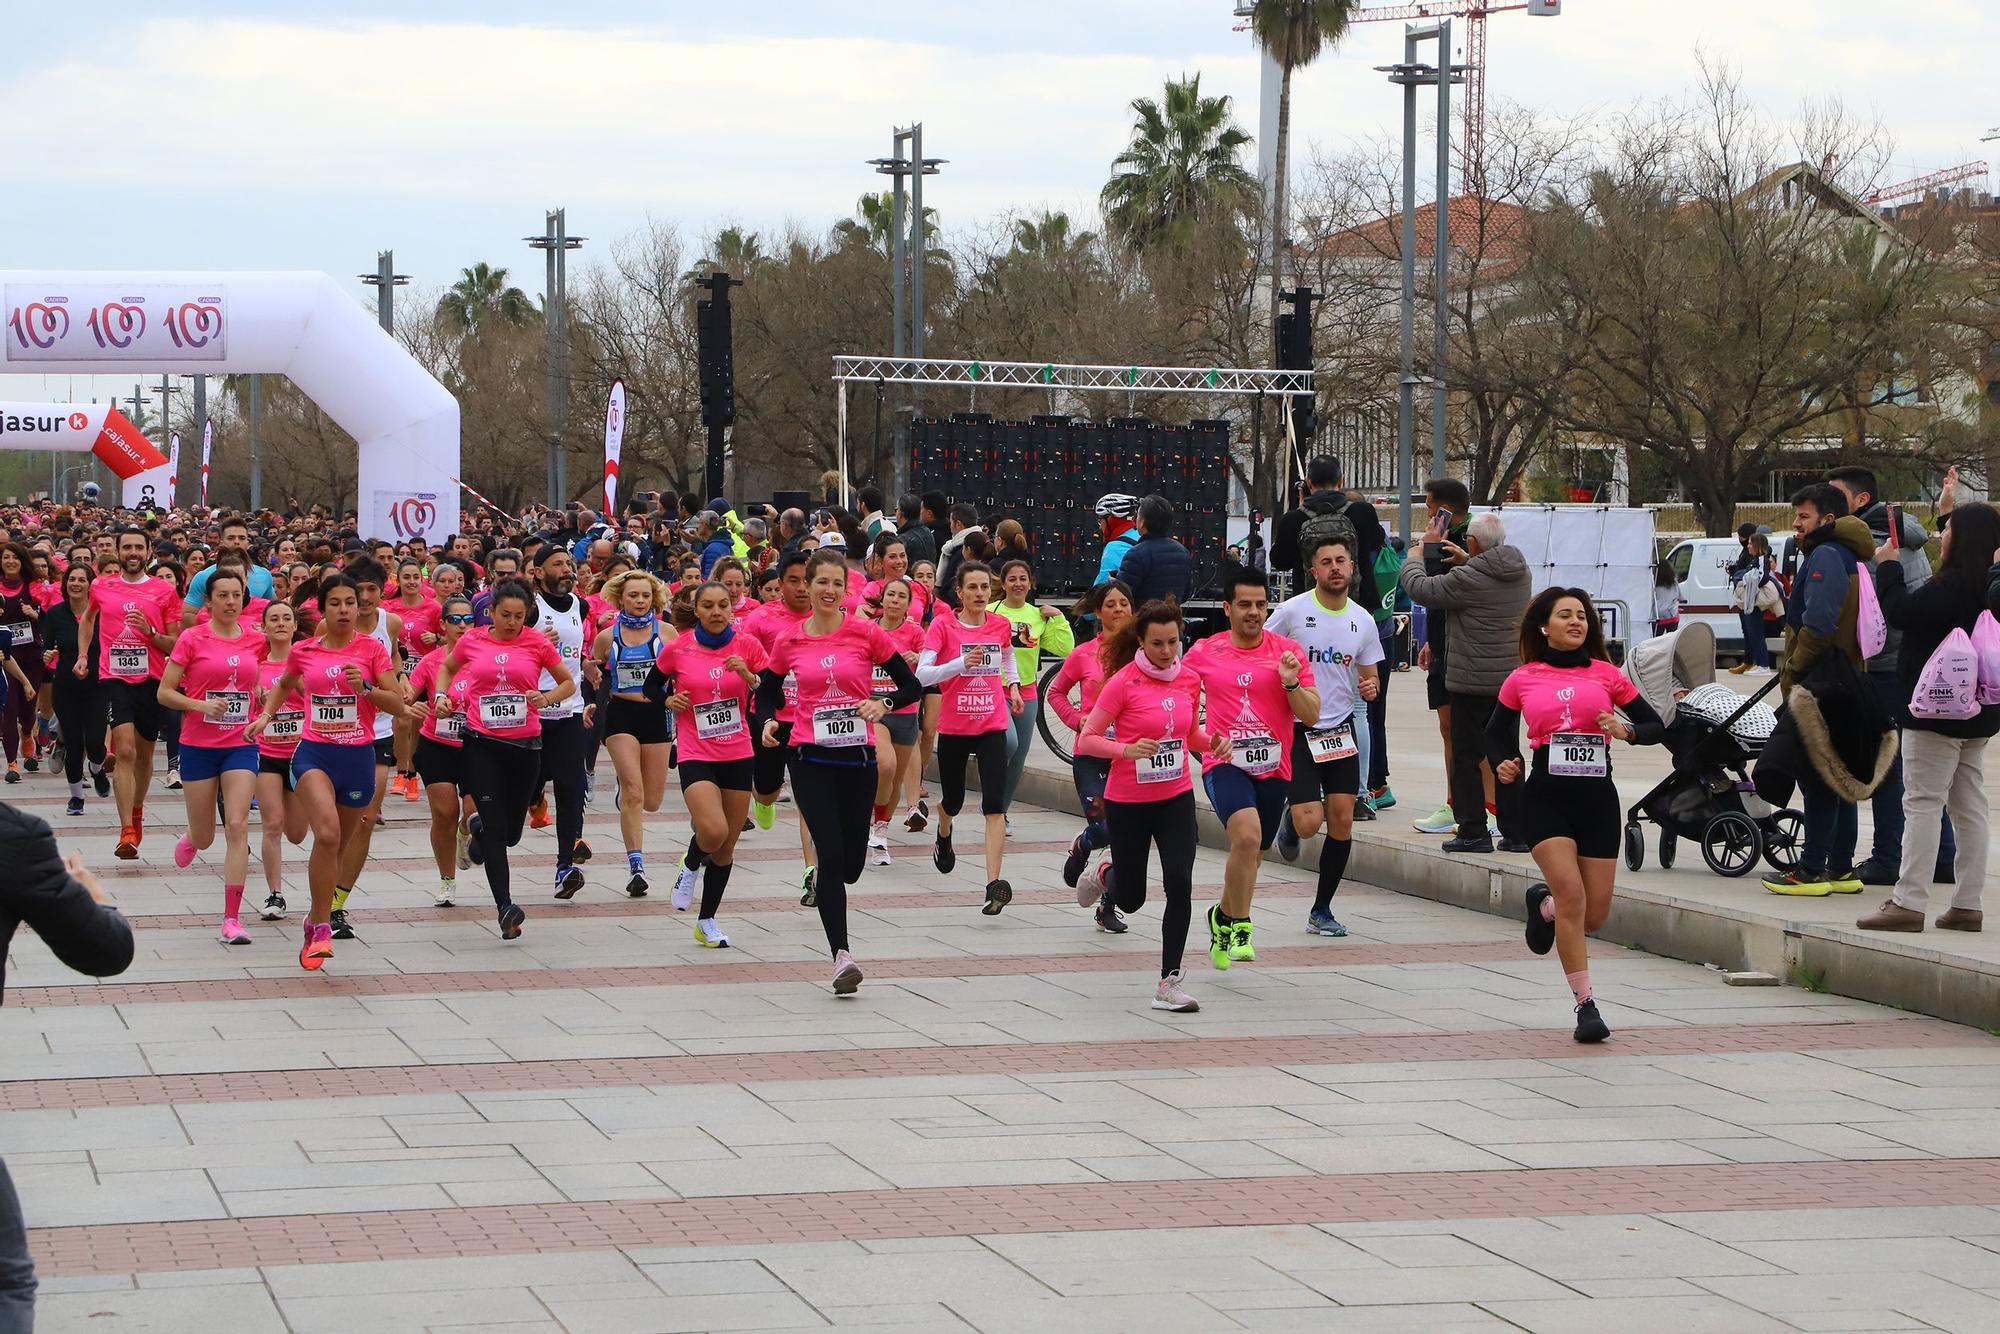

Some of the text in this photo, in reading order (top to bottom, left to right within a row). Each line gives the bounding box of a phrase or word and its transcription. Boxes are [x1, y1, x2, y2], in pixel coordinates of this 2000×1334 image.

[104, 428, 140, 460] cajasur
[118, 657, 139, 667] 1343
[1309, 646, 1352, 667] indea
[957, 694, 995, 706] PINK
[318, 707, 344, 720] 1704
[490, 705, 516, 717] 1054
[706, 710, 732, 726] 1389
[272, 721, 298, 734] 1896
[826, 720, 854, 735] 1020
[1319, 737, 1343, 751] 1798
[1150, 753, 1175, 769] 1419
[1245, 748, 1269, 763] 640
[1563, 747, 1595, 762] 1032
